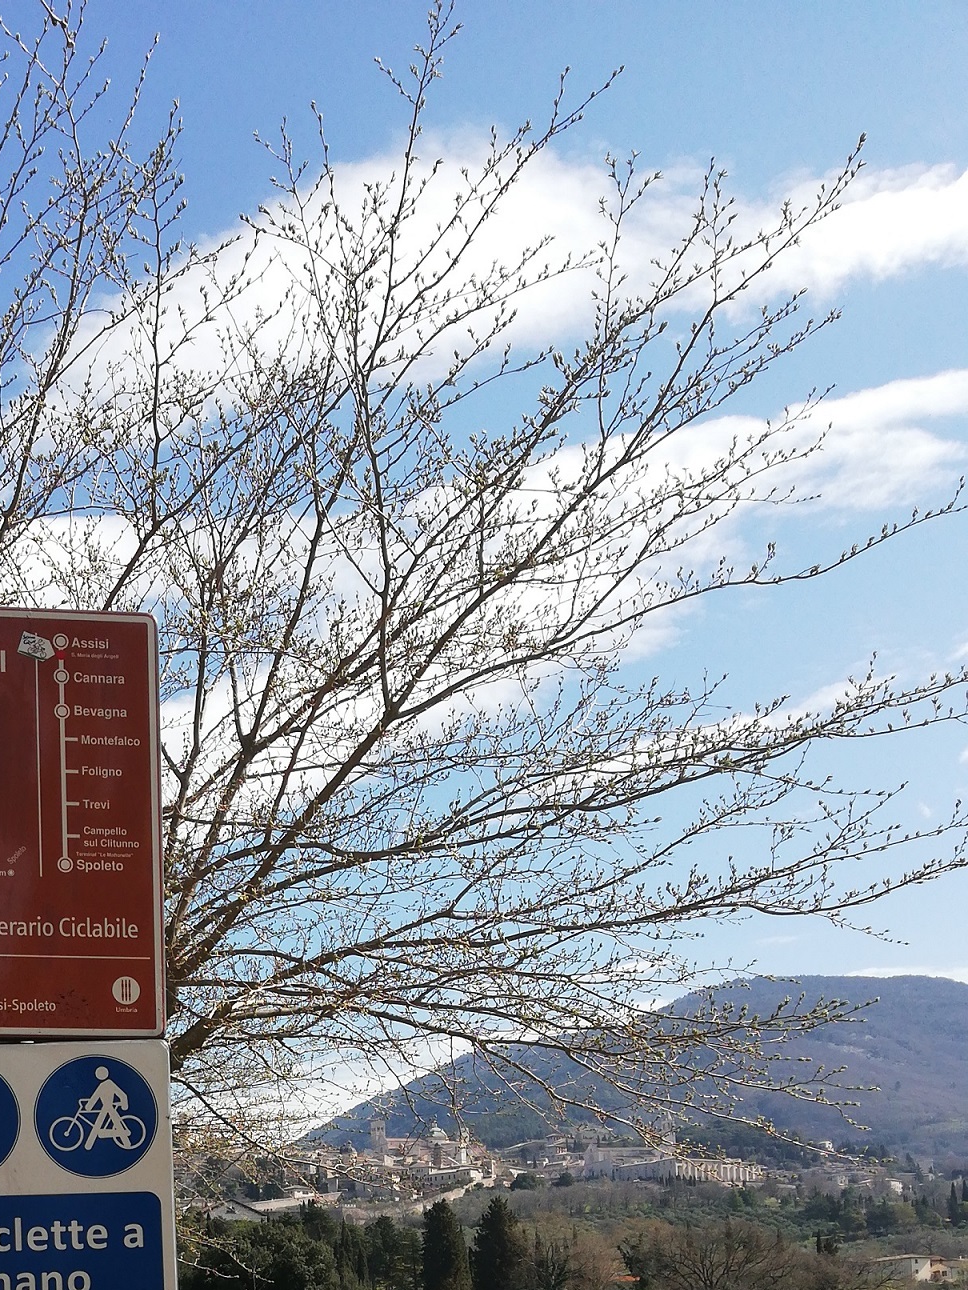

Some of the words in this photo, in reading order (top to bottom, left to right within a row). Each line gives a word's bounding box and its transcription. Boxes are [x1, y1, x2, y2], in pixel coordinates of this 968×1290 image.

[71, 637, 109, 649] Assisi
[73, 672, 125, 684] Cannara
[74, 706, 127, 719] Bevagna
[81, 734, 141, 747] Montefalco
[81, 766, 123, 778] Foligno
[83, 799, 110, 810] Trevi
[83, 826, 127, 837] Campello
[84, 839, 98, 847] sul
[100, 839, 140, 848] Clitunno
[7, 845, 27, 865] Spoleto
[76, 860, 124, 873] Spoleto
[58, 917, 139, 939] Ciclabile
[123, 1222, 145, 1248] a
